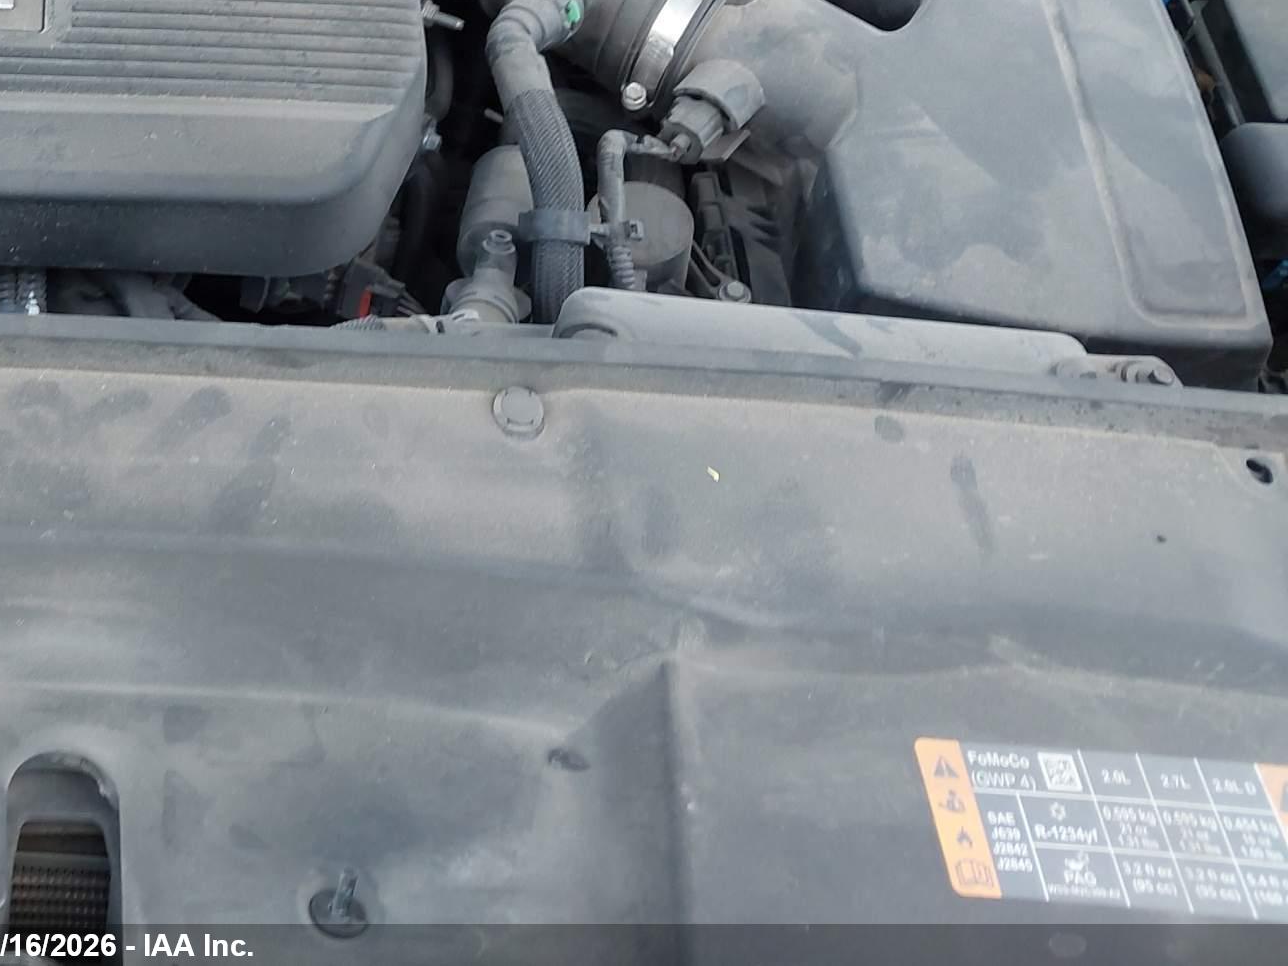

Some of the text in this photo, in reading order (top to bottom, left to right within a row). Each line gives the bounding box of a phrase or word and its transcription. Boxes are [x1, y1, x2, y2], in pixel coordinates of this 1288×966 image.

[967, 750, 1030, 769] FoMoCo
[1160, 773, 1191, 790] 2.7L
[987, 811, 1015, 826] SAE
